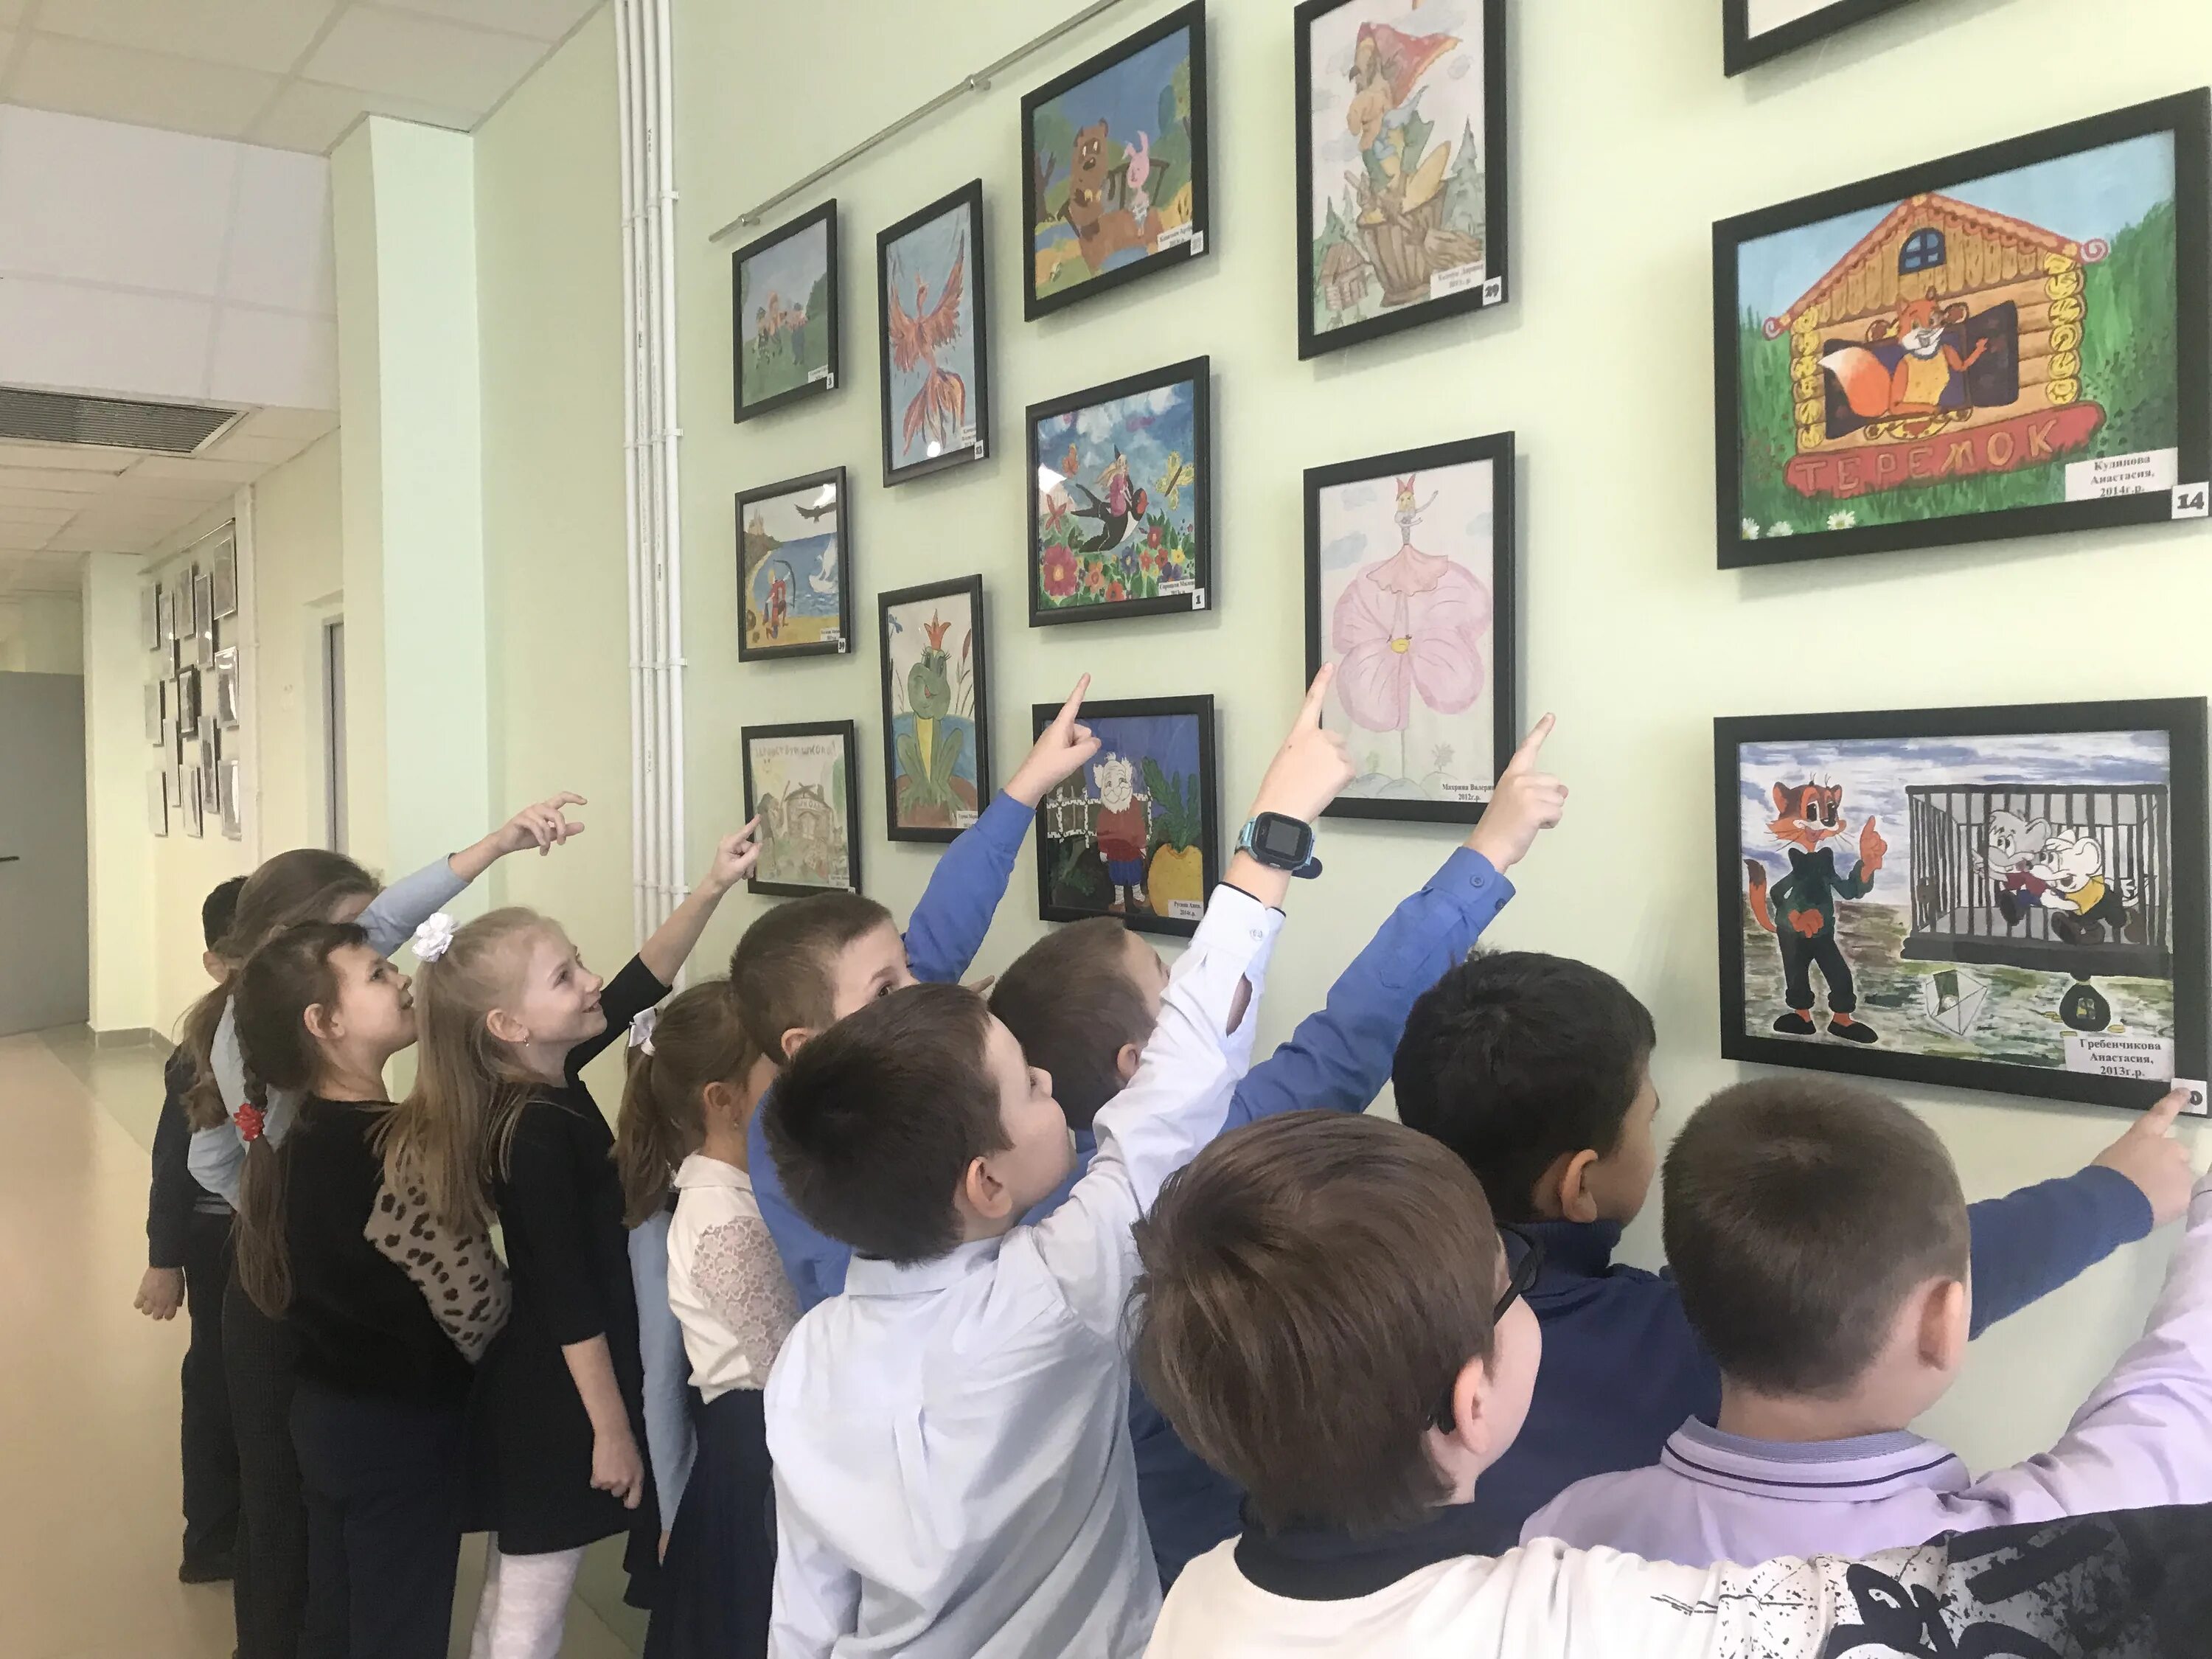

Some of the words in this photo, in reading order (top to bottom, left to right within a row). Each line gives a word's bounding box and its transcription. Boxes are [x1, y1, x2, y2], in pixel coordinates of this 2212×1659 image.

[1794, 419, 2058, 492] ТЕРЕМОК
[2177, 491, 2205, 509] 14
[1196, 595, 1201, 605] 1
[2079, 1039, 2162, 1051] Гребенчикова
[2090, 1053, 2154, 1065] Анастасия,
[2101, 1066, 2145, 1078] 2013г.р.
